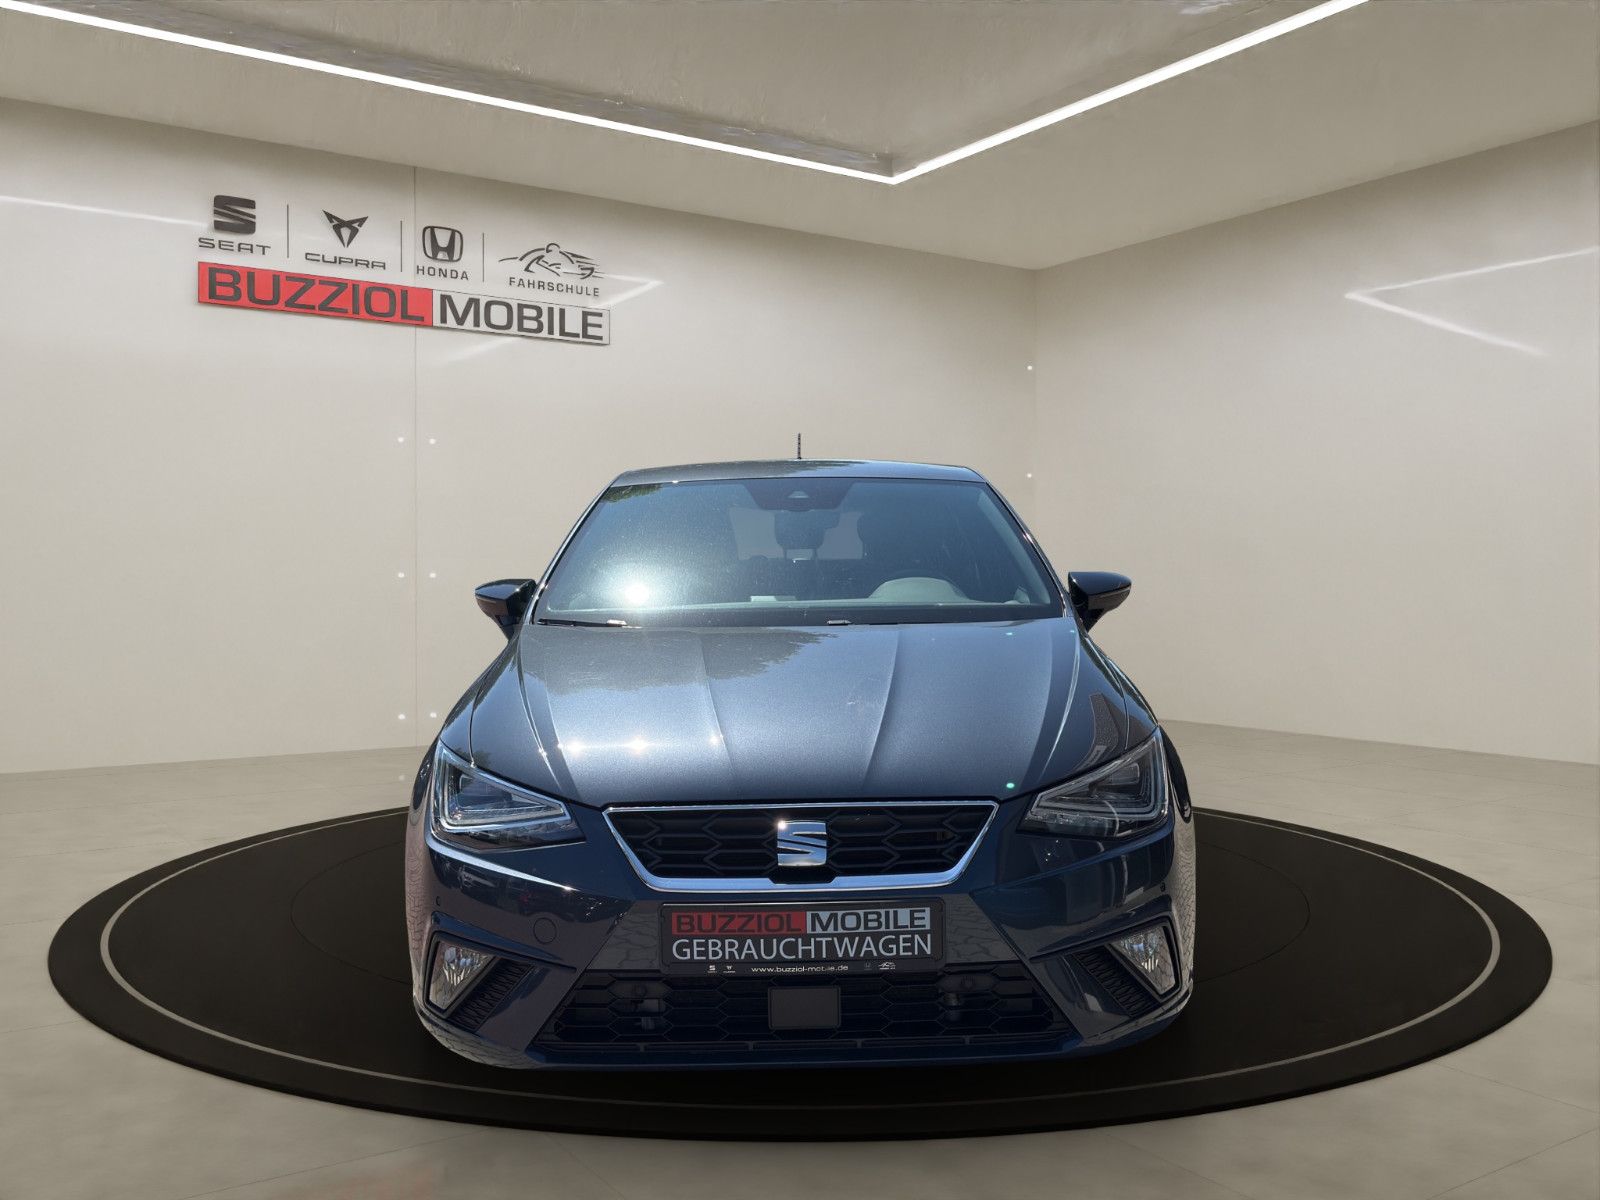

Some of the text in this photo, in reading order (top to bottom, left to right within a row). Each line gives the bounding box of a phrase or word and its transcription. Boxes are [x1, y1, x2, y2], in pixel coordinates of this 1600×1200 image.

[198, 237, 271, 255] SEAT
[304, 252, 386, 270] CUPRA
[416, 265, 469, 280] HONDA
[509, 277, 600, 297] FAHRSCHULE
[208, 267, 603, 341] BUZZIOL MOBILE
[676, 909, 926, 934] BUZZIOL MOBILE
[672, 934, 932, 960] GEBRAUCHTWAGEN
[751, 965, 849, 973] www.buzziol-mobe.de
